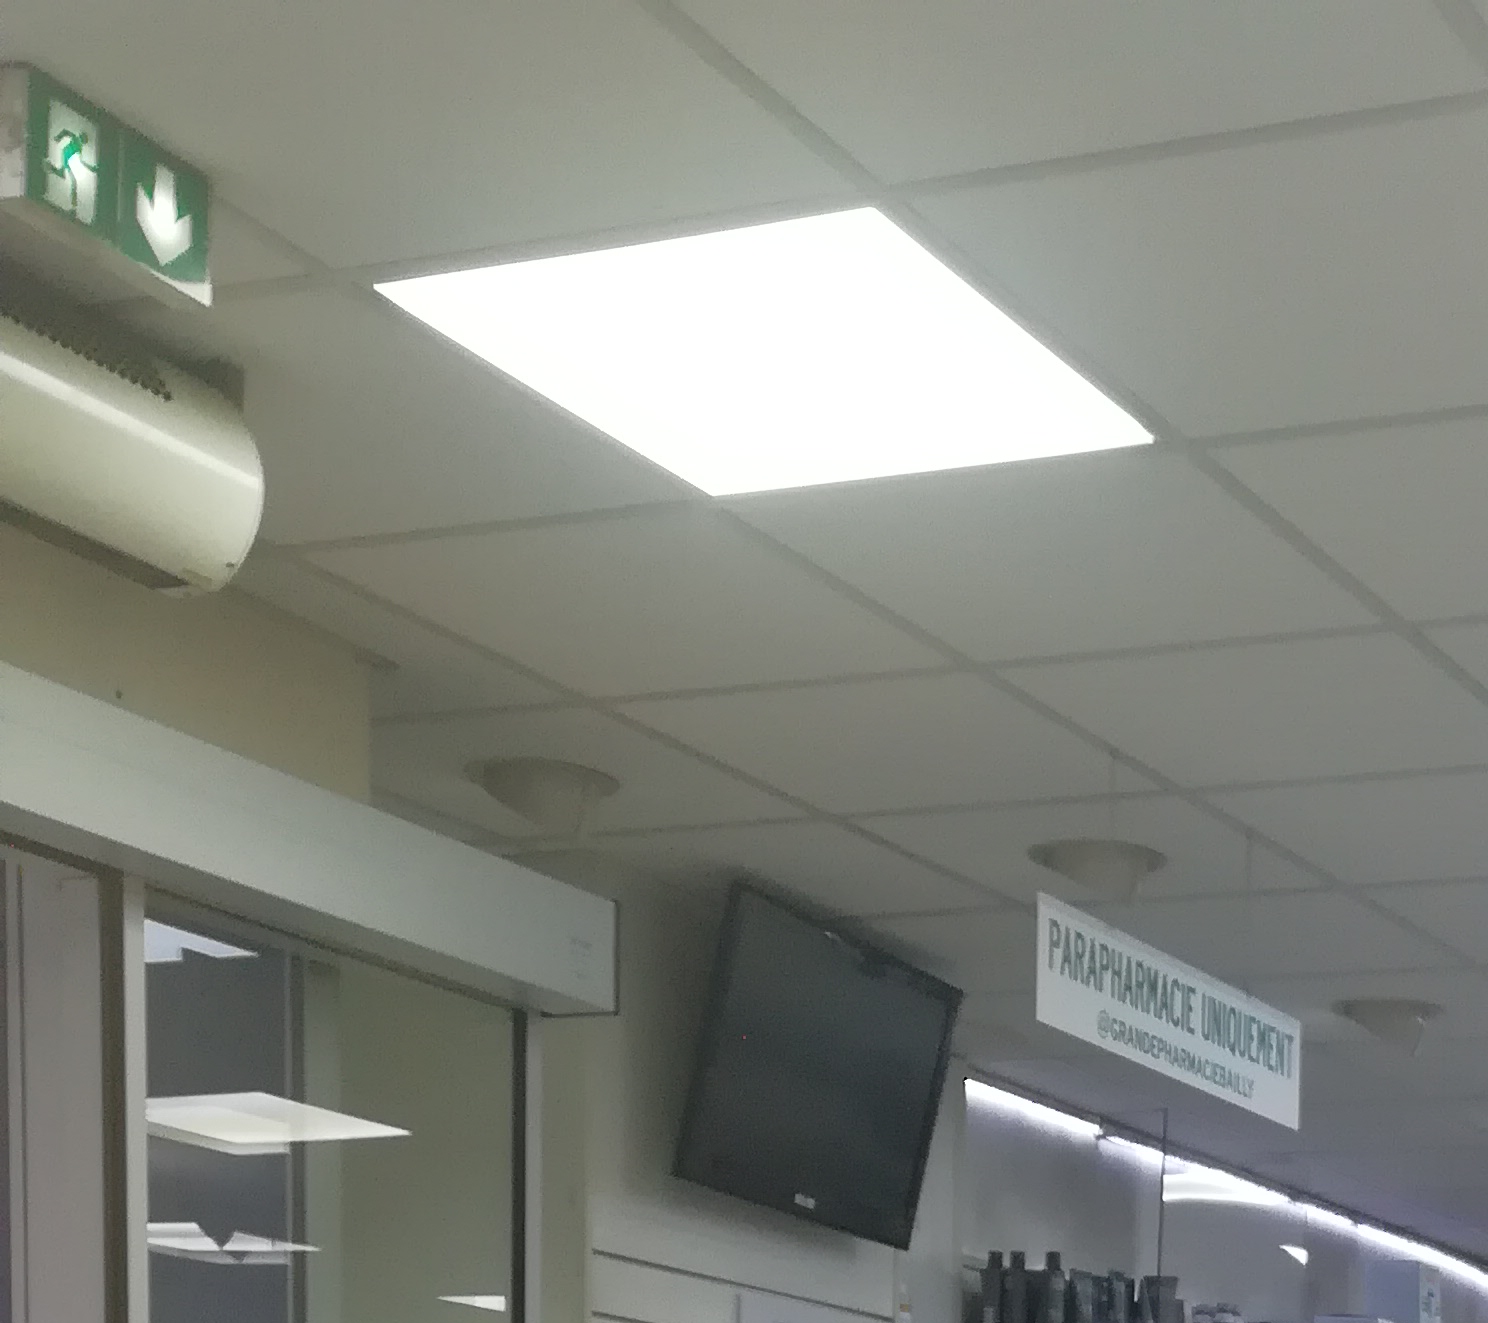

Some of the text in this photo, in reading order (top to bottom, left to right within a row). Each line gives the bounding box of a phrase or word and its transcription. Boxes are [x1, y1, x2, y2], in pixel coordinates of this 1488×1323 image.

[1048, 917, 1294, 1080] PARAPHARMACIE UNIQUEMENT
[1096, 1008, 1256, 1099] @GRANDEPHARMACIEBAILLY
